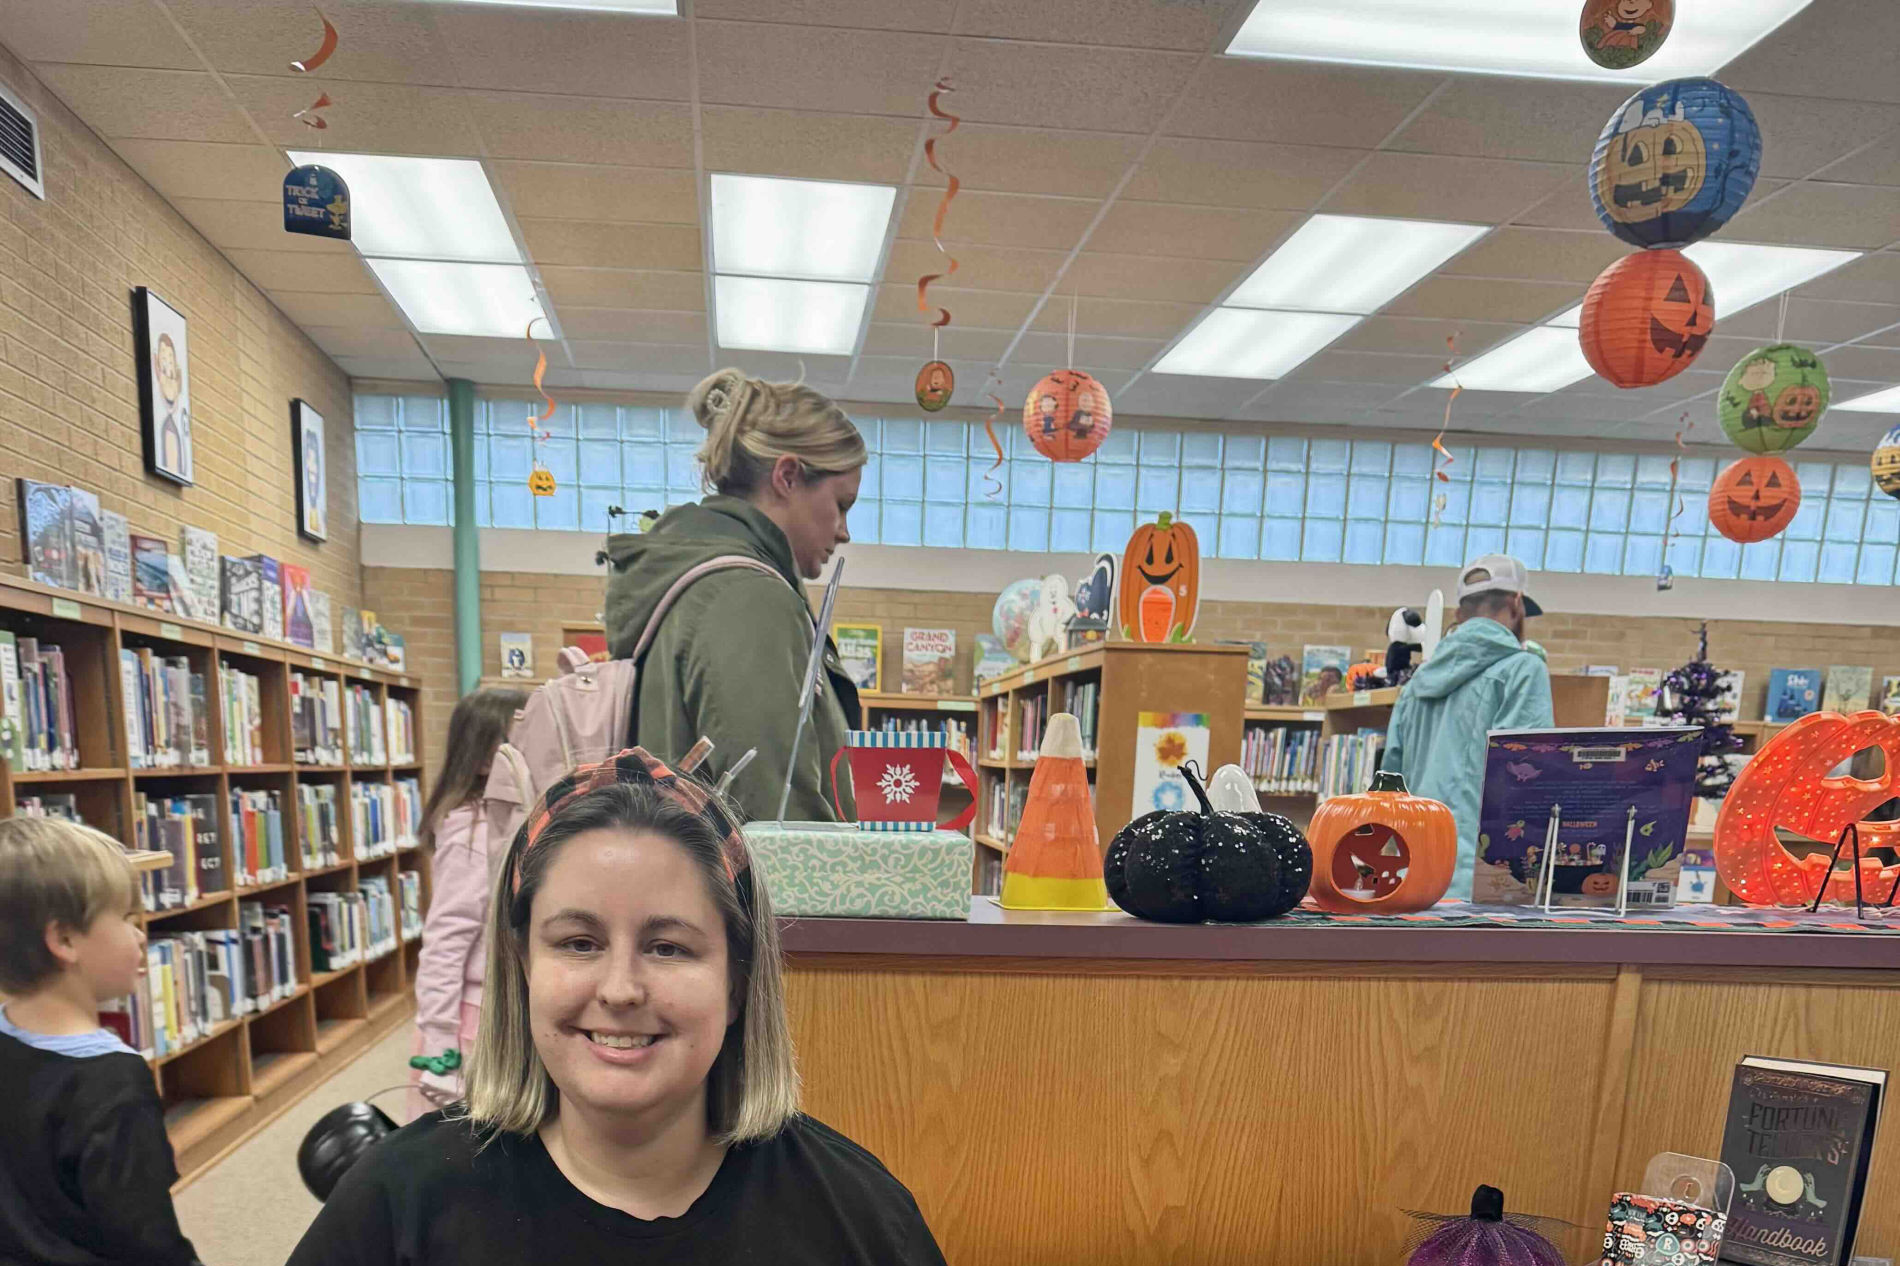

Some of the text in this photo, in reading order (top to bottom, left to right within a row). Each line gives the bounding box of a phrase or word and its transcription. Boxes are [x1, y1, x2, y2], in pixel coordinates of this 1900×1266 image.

[286, 185, 319, 198] TRICK
[288, 204, 326, 218] TWEET
[910, 631, 949, 642] GRAND
[906, 641, 953, 653] CANYON
[1727, 1216, 1829, 1258] Handbook
